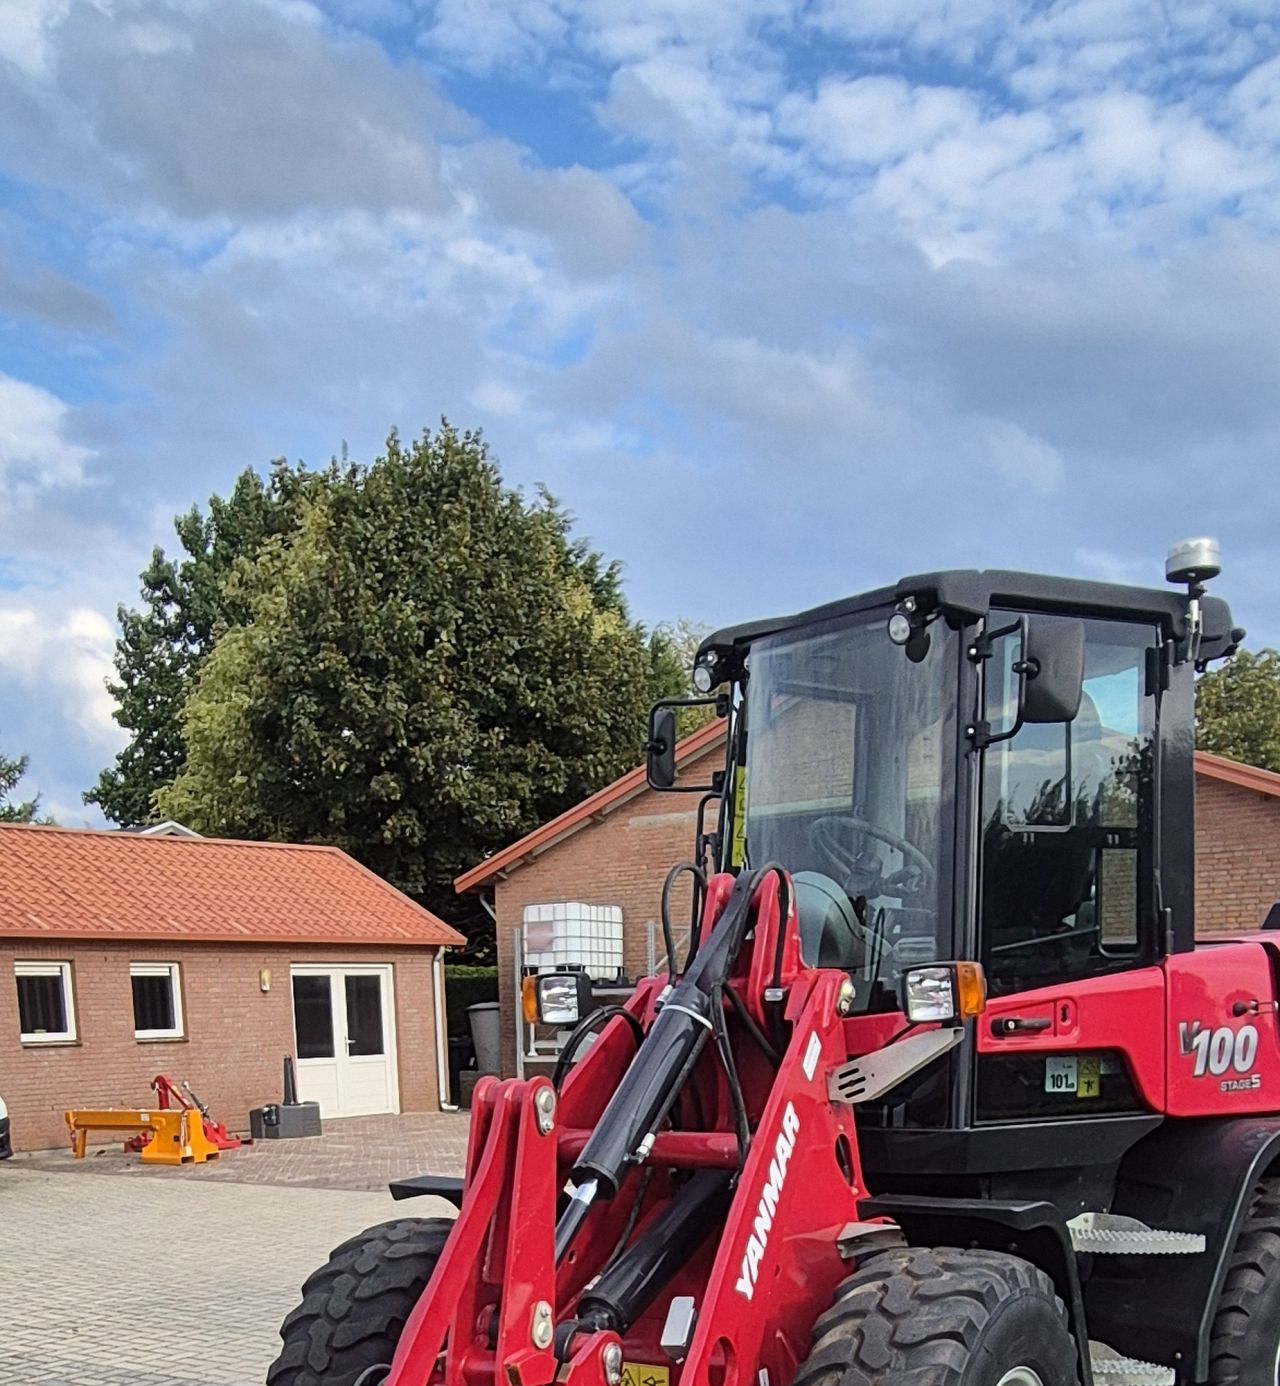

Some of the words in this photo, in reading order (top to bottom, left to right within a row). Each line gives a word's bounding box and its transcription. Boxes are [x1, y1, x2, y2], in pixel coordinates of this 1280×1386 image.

[1178, 1021, 1259, 1077] V100
[1050, 1073, 1069, 1089] 101
[735, 1100, 800, 1300] YANMAR
